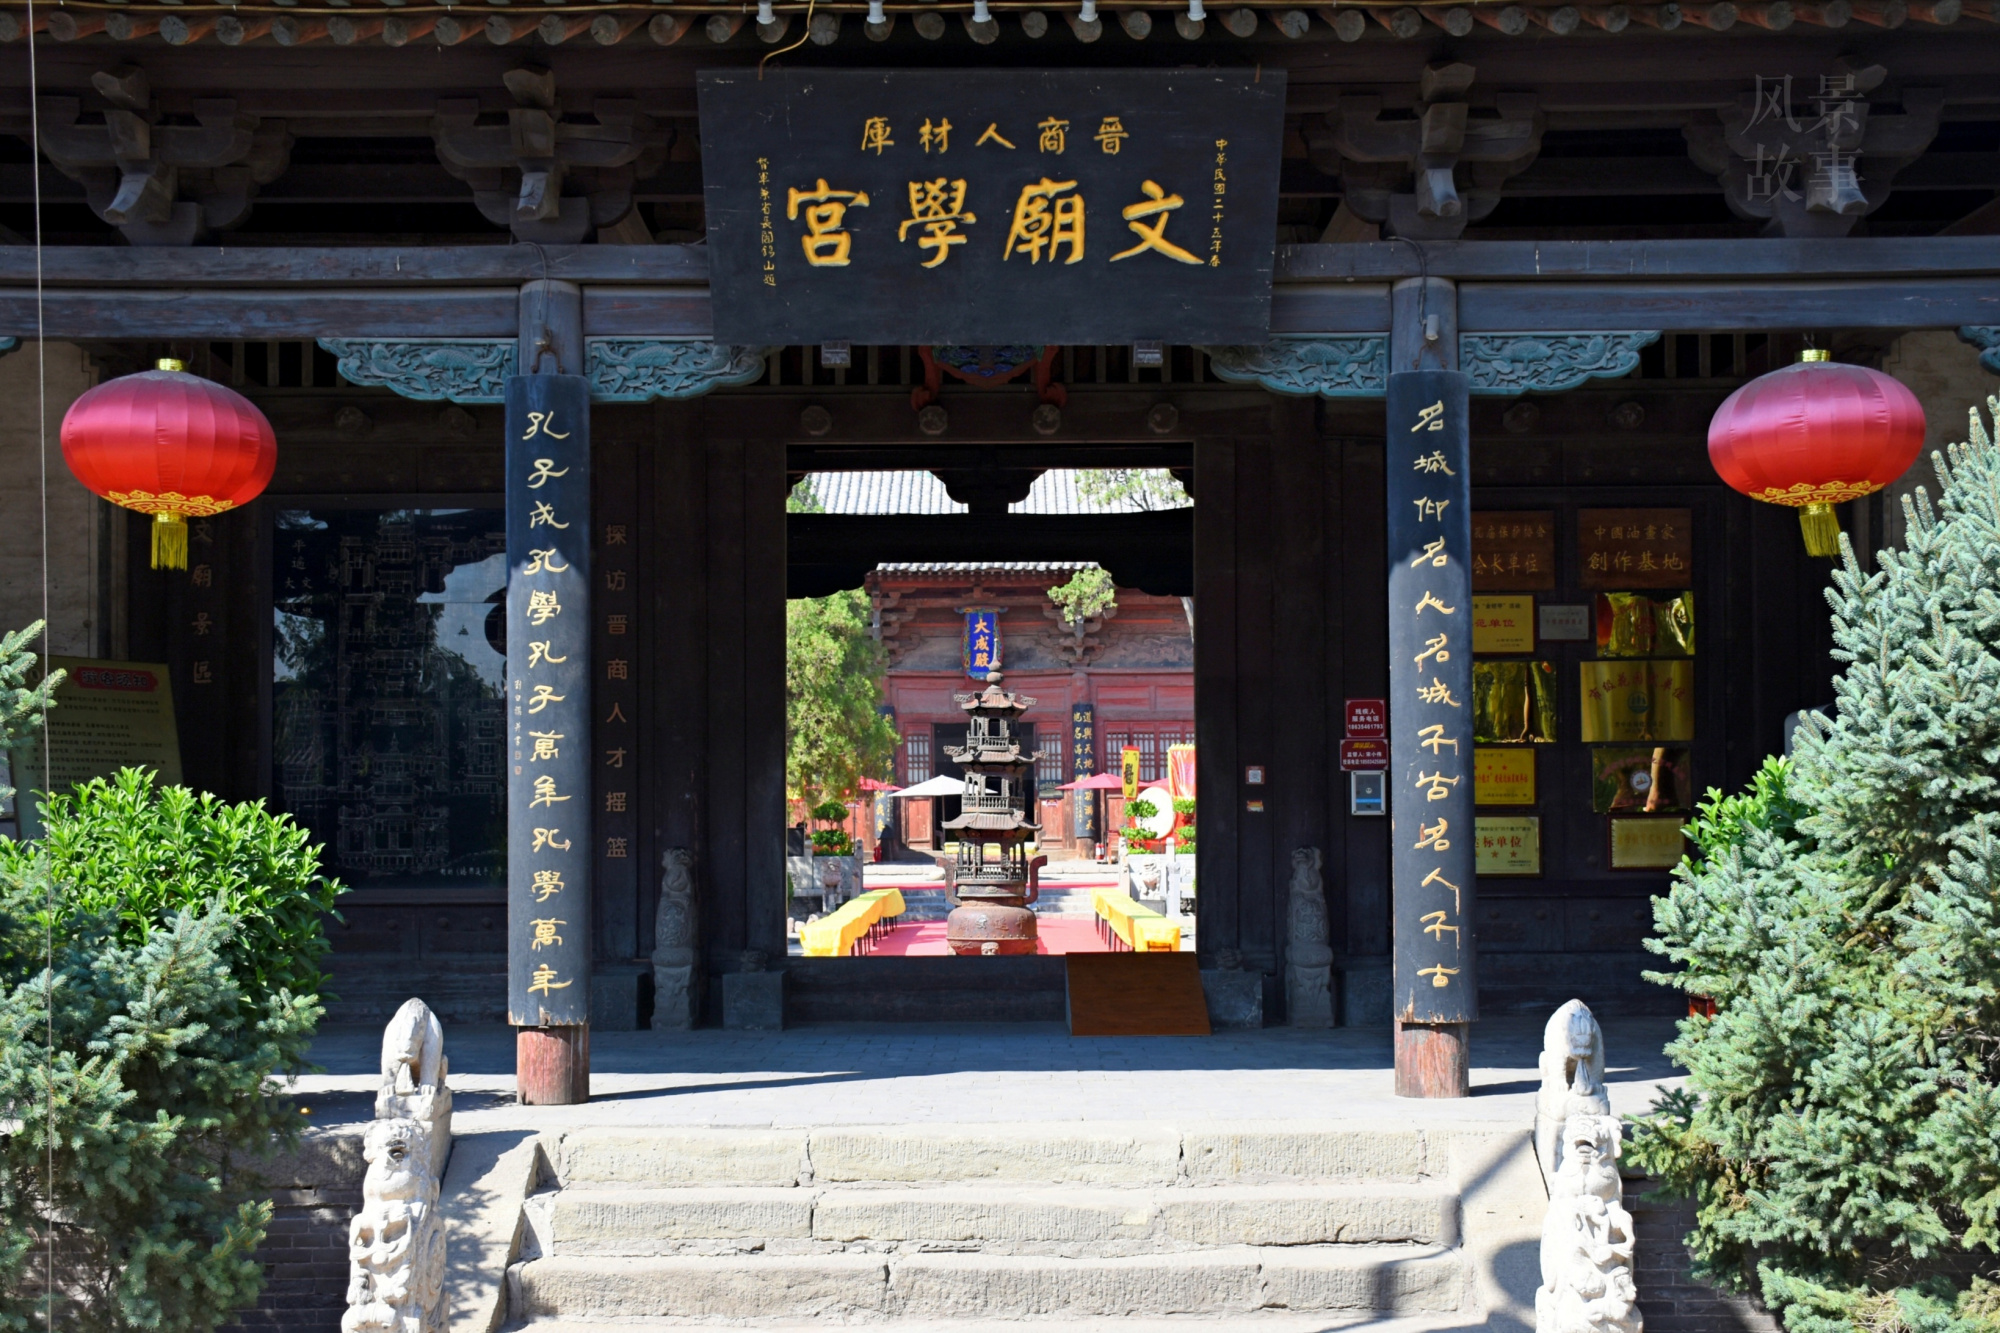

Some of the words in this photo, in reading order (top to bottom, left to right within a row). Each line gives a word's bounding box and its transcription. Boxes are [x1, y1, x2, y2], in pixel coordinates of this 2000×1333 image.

[605, 524, 628, 858] 探访晋商人才摇篮
[973, 618, 991, 668] 大成殿
